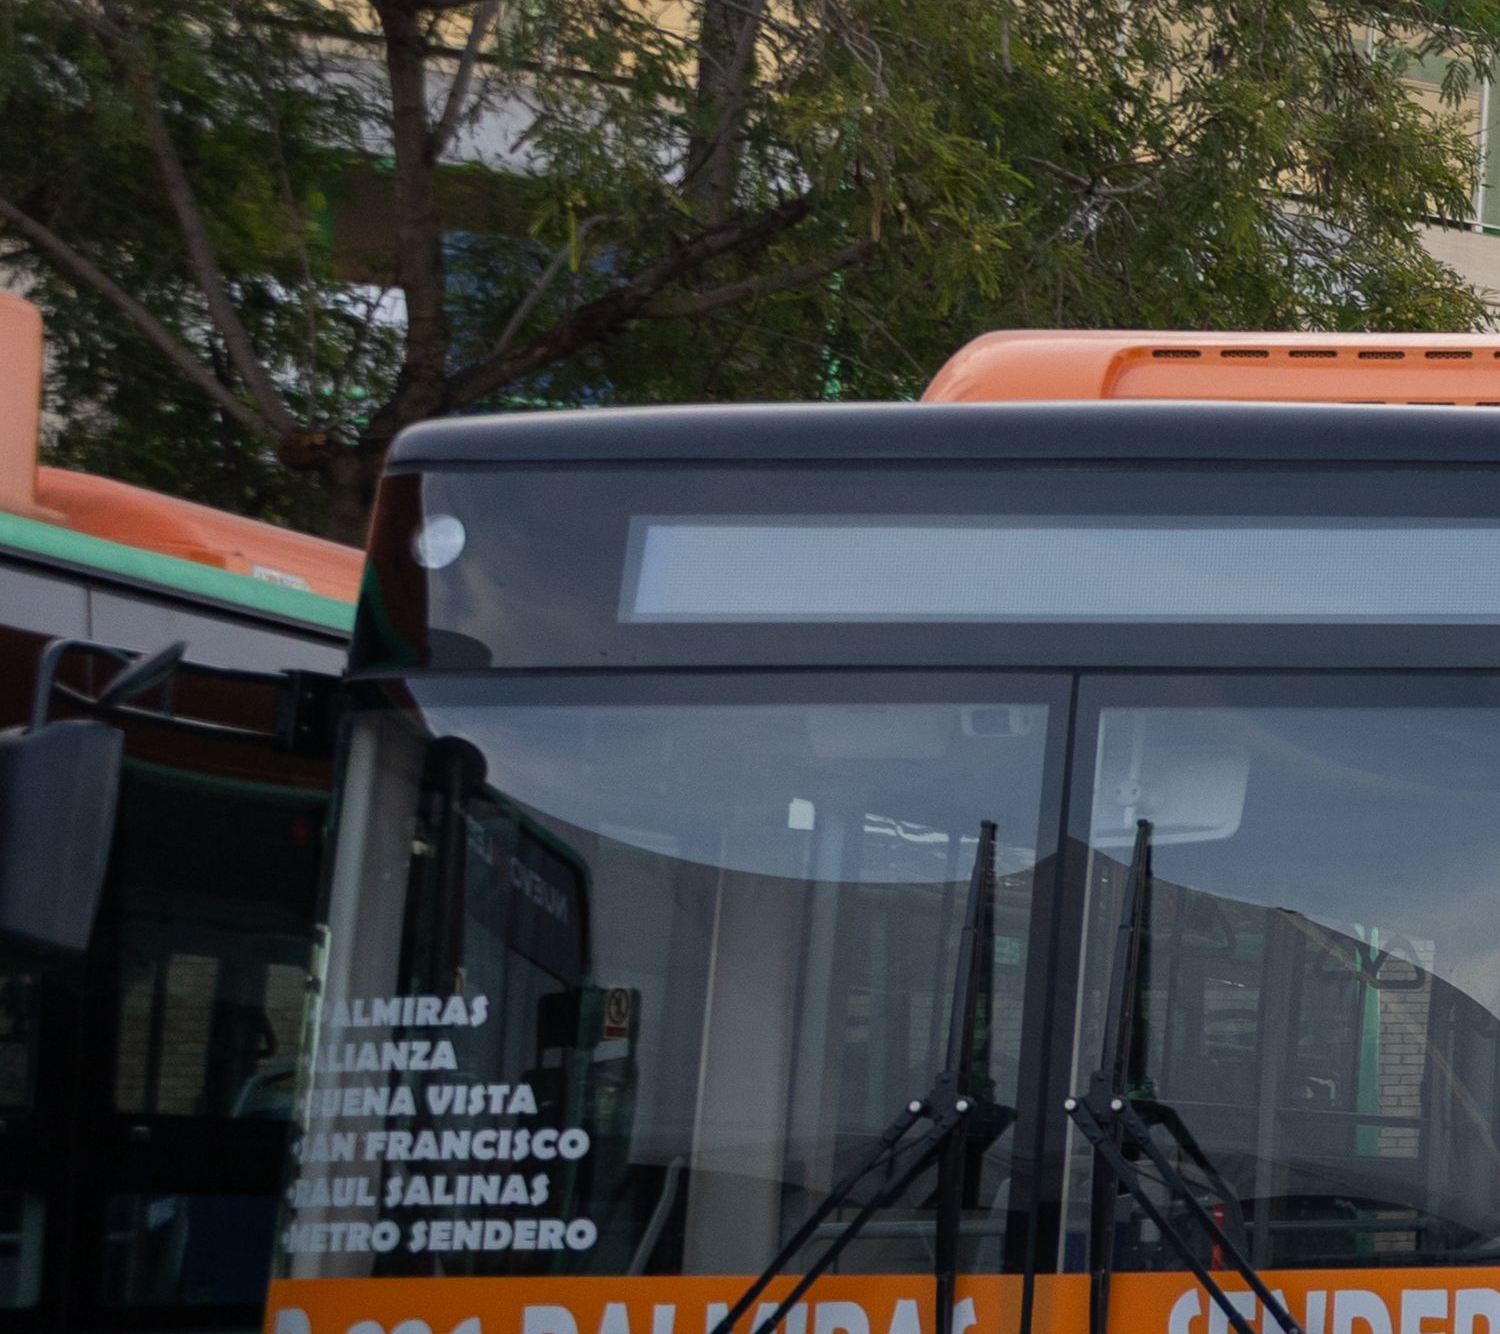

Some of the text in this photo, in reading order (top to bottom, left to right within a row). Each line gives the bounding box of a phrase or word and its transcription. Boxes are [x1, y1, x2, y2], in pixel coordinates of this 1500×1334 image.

[425, 1084, 538, 1115] VISTA
[364, 1128, 591, 1162] FRANCISCO
[384, 1173, 551, 1206] SALINAS
[408, 1218, 598, 1253] SENDERO
